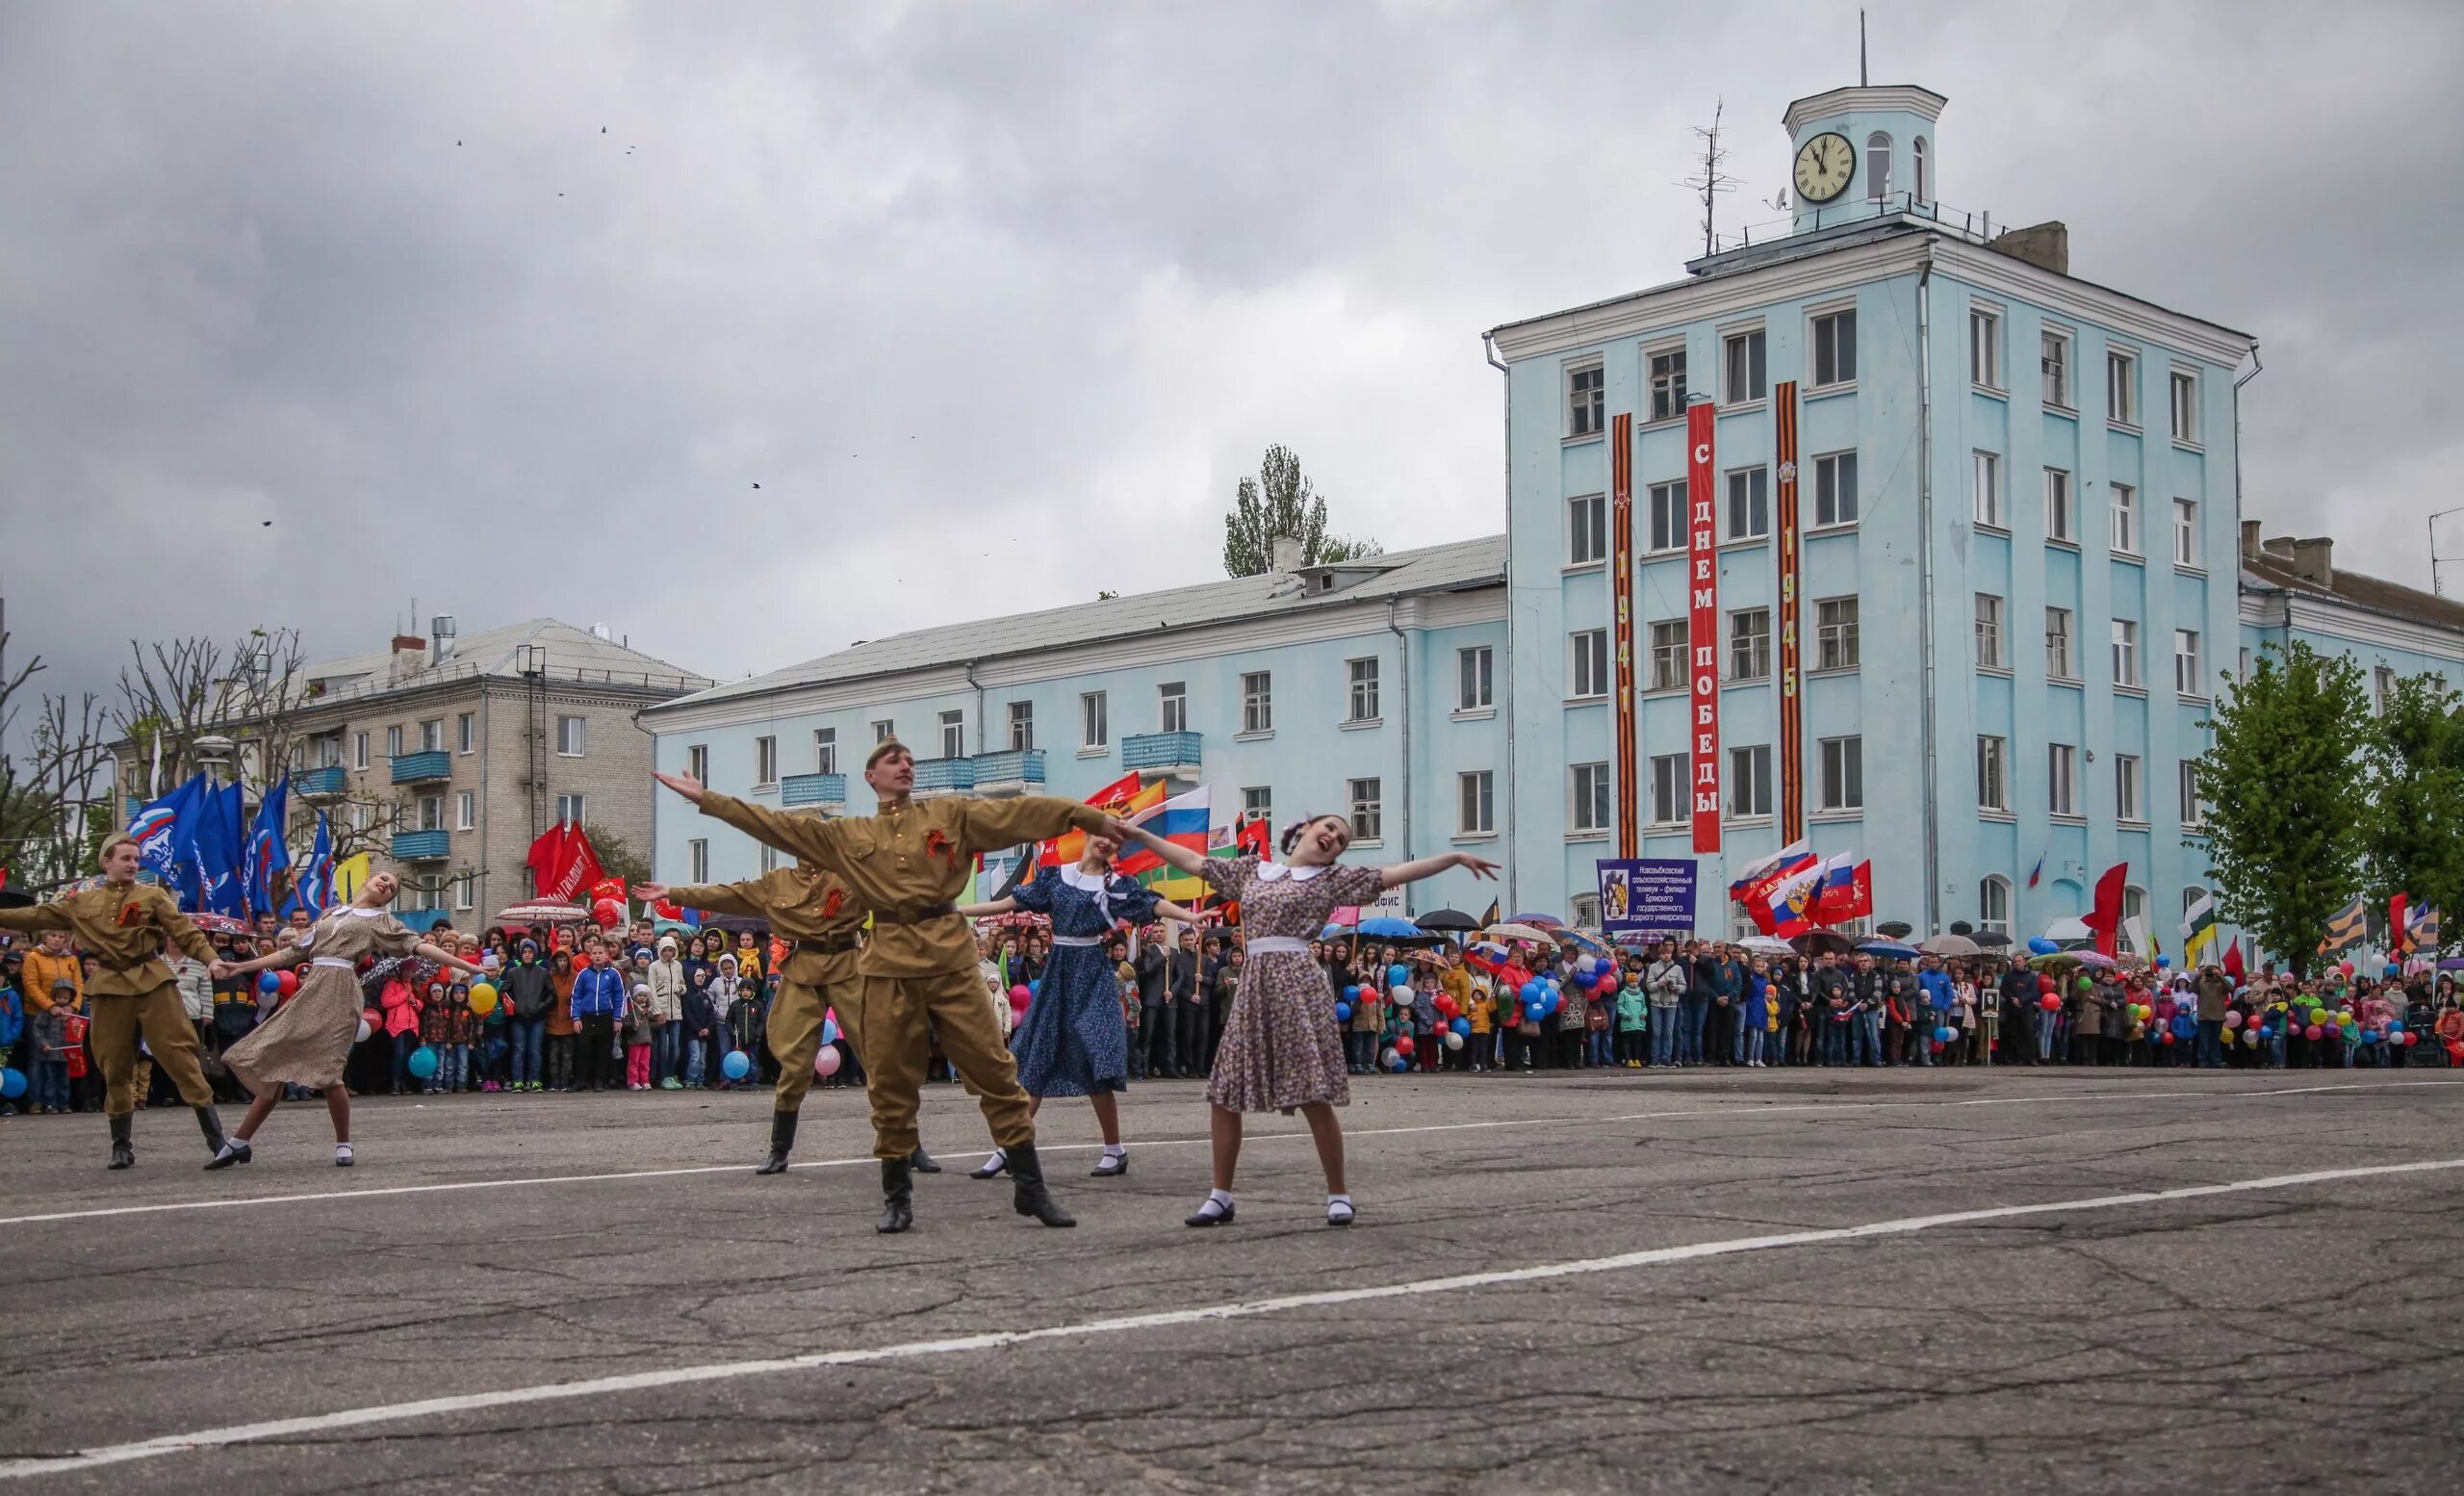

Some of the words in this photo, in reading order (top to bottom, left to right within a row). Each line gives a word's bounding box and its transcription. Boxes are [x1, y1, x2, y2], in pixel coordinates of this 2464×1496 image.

[1695, 444, 1709, 464] С
[1694, 502, 1713, 609] ДНЕМ
[1617, 550, 1630, 713] 1941
[1782, 526, 1797, 698] 1945
[1696, 646, 1718, 813] ПОБЕДЫ
[1646, 894, 1673, 903] Брянского
[1664, 886, 1686, 894] филиал
